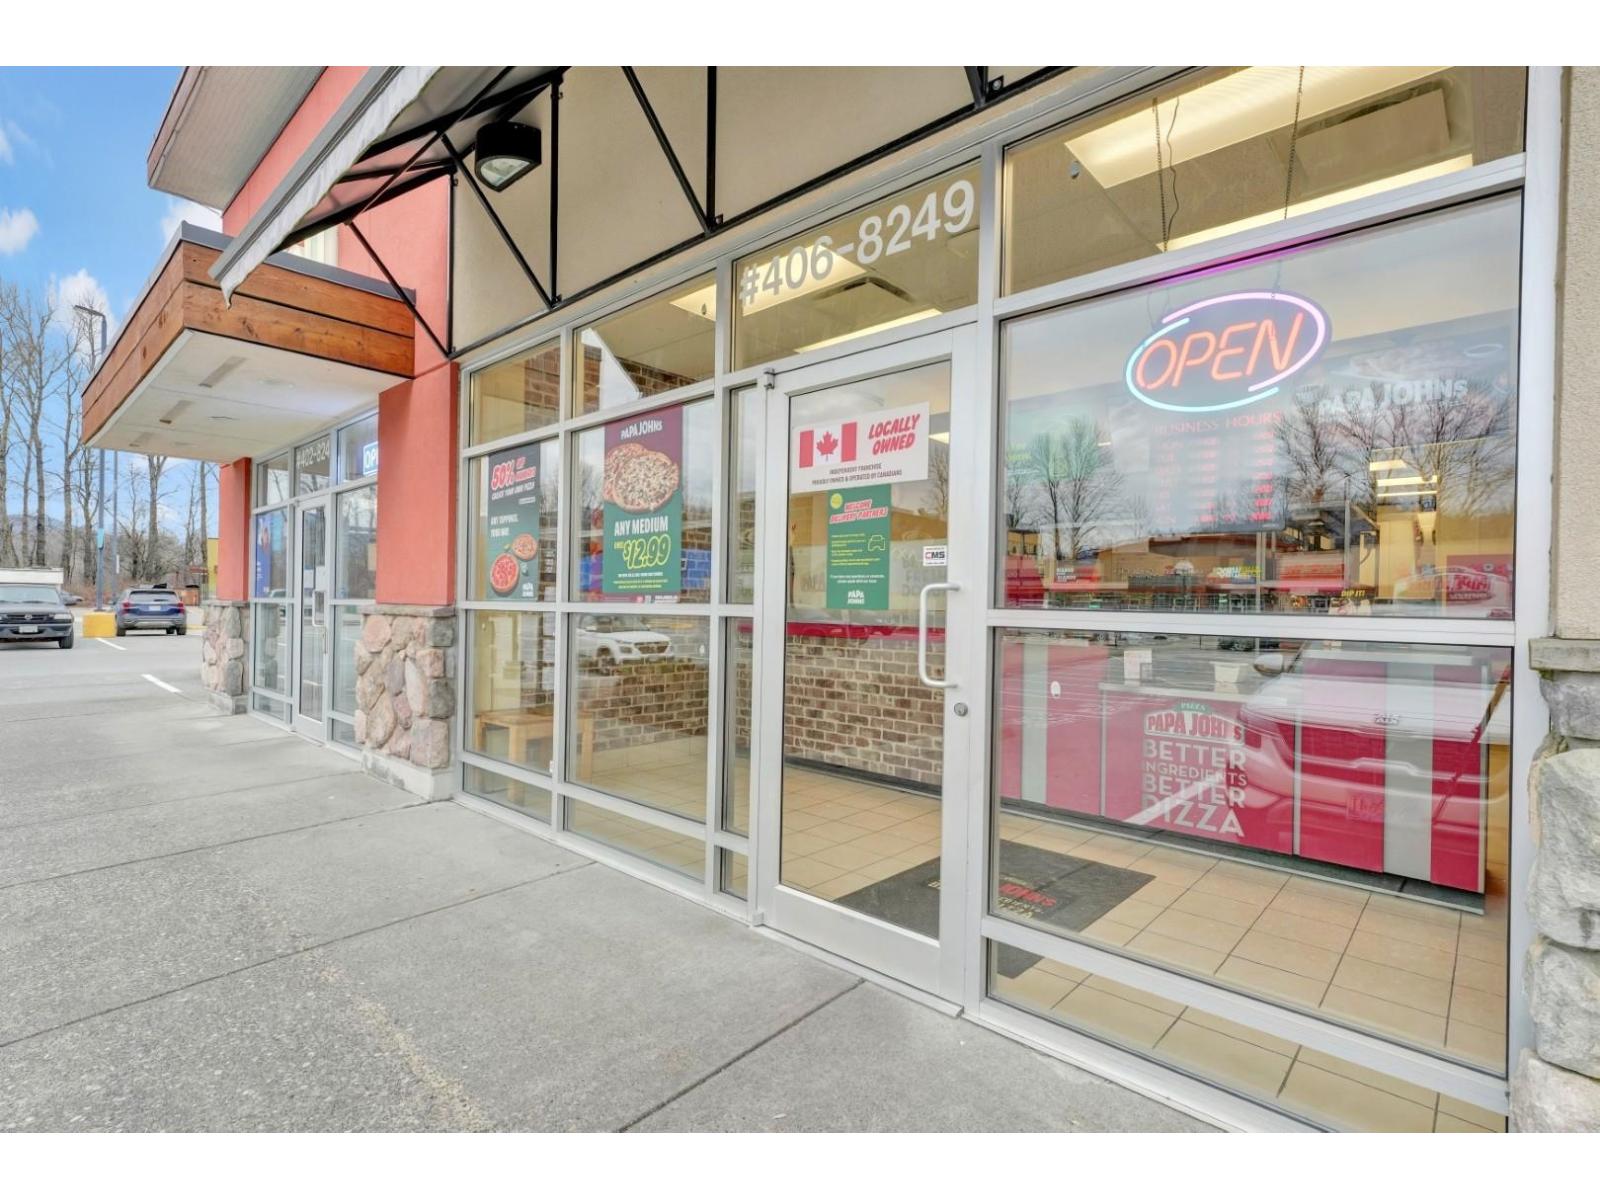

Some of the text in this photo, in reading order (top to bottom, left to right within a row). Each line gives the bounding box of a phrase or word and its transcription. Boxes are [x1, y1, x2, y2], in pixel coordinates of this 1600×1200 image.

[740, 179, 975, 305] #406-8249
[1135, 312, 1305, 390] OPEN
[620, 423, 638, 440] PAPA
[868, 413, 921, 440] LOCALLY
[872, 432, 916, 455] OWNED
[491, 459, 515, 491] 50%
[614, 515, 669, 537] ANY MEDIUM
[622, 533, 671, 570] $12.99
[1148, 712, 1186, 735] PAPA
[1143, 739, 1247, 771] BETTER
[1144, 761, 1248, 786] NGREDIENTS
[1143, 774, 1247, 808] BETTER
